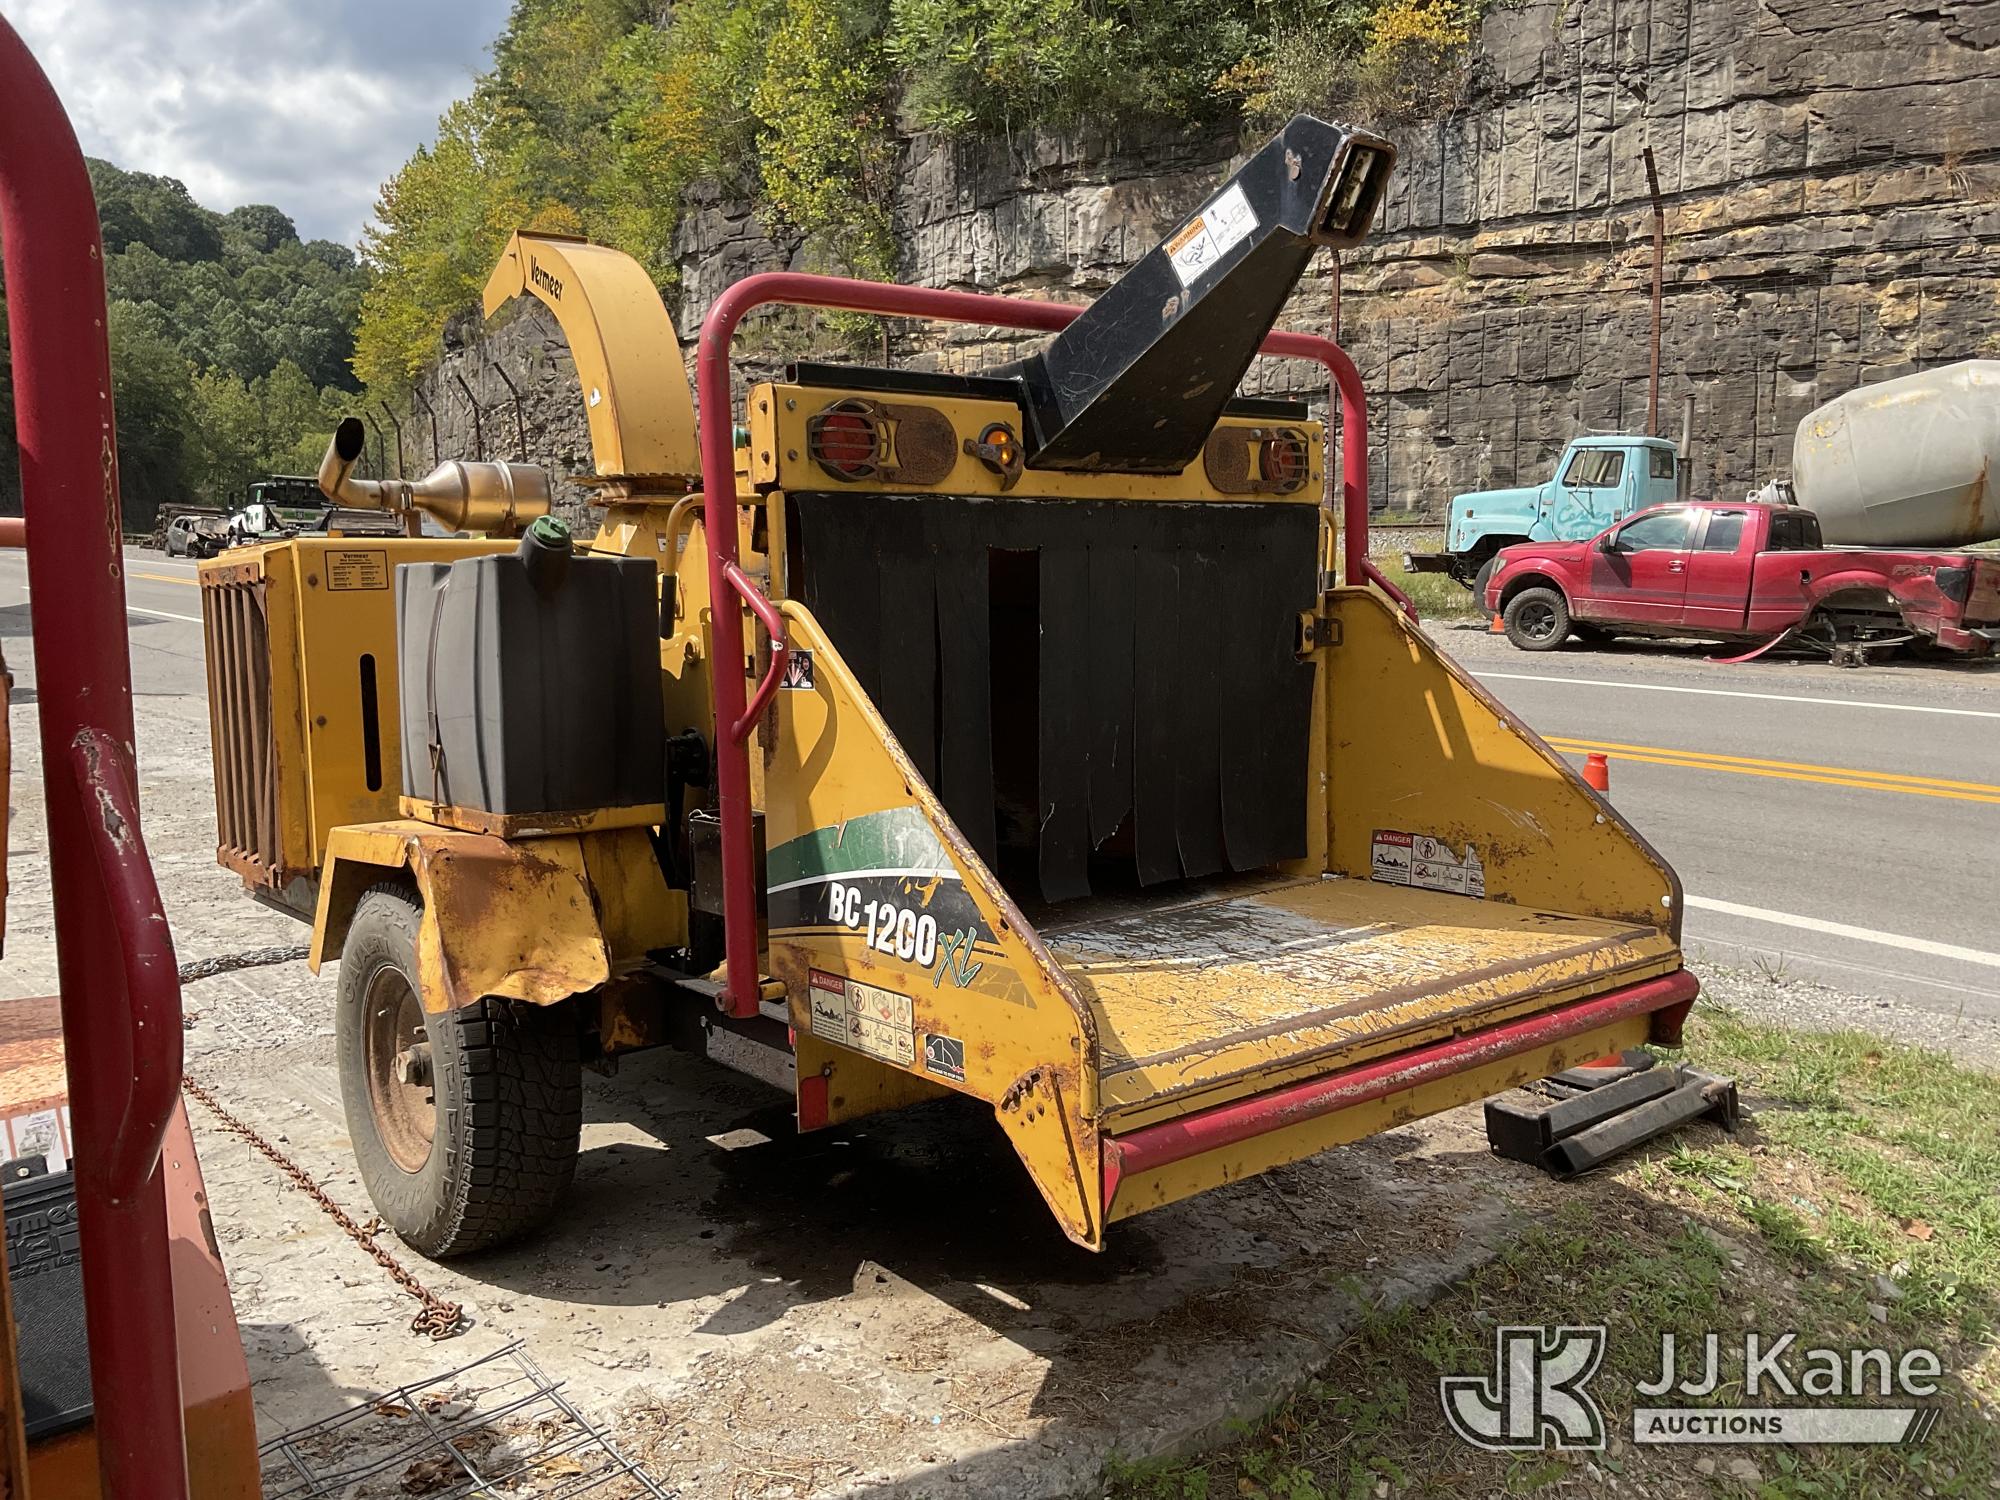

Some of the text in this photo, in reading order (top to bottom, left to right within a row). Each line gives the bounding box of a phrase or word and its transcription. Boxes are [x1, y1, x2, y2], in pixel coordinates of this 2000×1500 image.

[531, 254, 562, 301] Vermeer
[1892, 564, 1934, 576] FX4
[1383, 834, 1411, 844] DANGER
[828, 882, 937, 966] BC 1200
[933, 926, 983, 988] XL
[819, 975, 844, 990] DANGER
